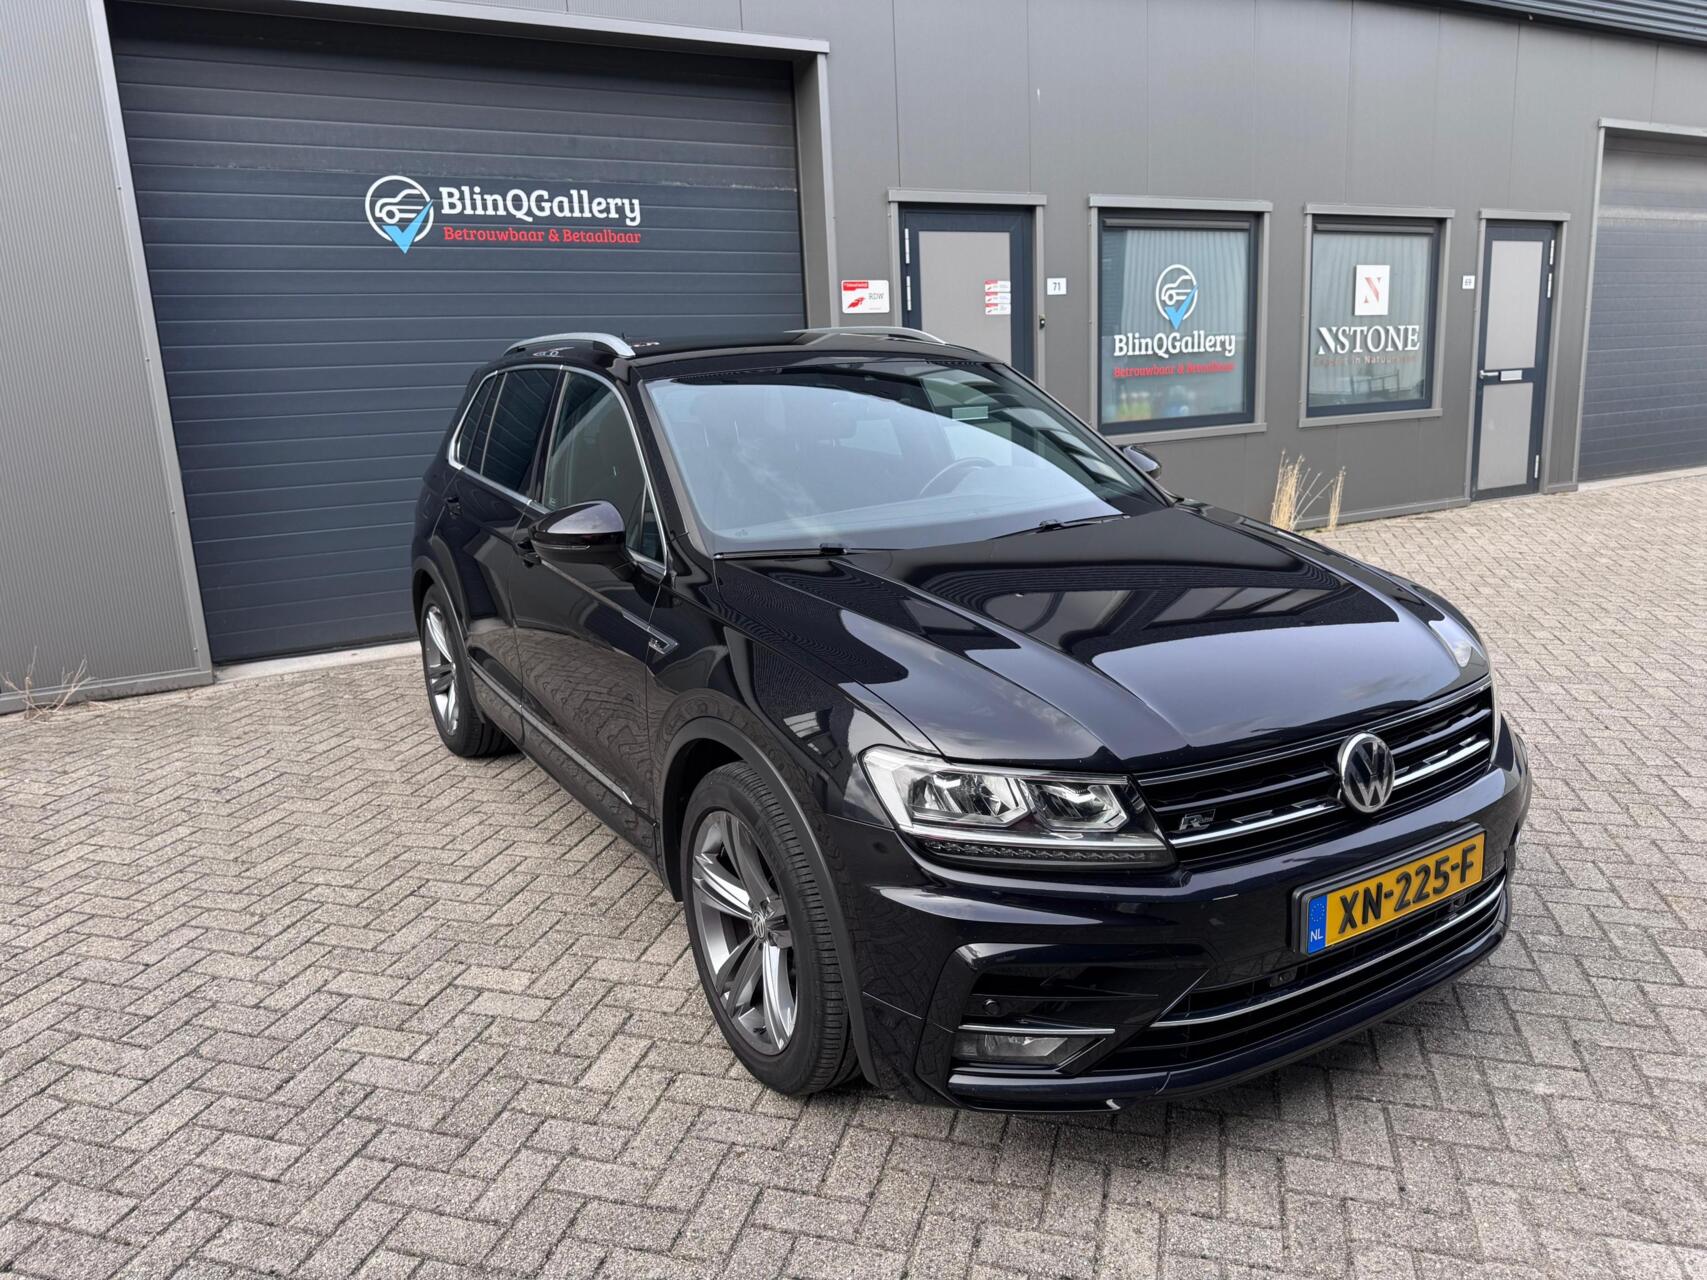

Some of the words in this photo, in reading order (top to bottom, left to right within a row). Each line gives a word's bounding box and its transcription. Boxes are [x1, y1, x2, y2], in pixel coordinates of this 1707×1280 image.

[439, 186, 641, 226] BlinQGallery
[443, 226, 545, 242] Betrouwbaar
[548, 229, 561, 243] &
[563, 229, 641, 244] Betaalbaar
[1053, 282, 1061, 291] 71
[1113, 331, 1236, 358] BlinQGallery
[1318, 325, 1420, 355] NSTONE
[1338, 844, 1477, 934] XN-225-F
[1310, 928, 1324, 942] NL
